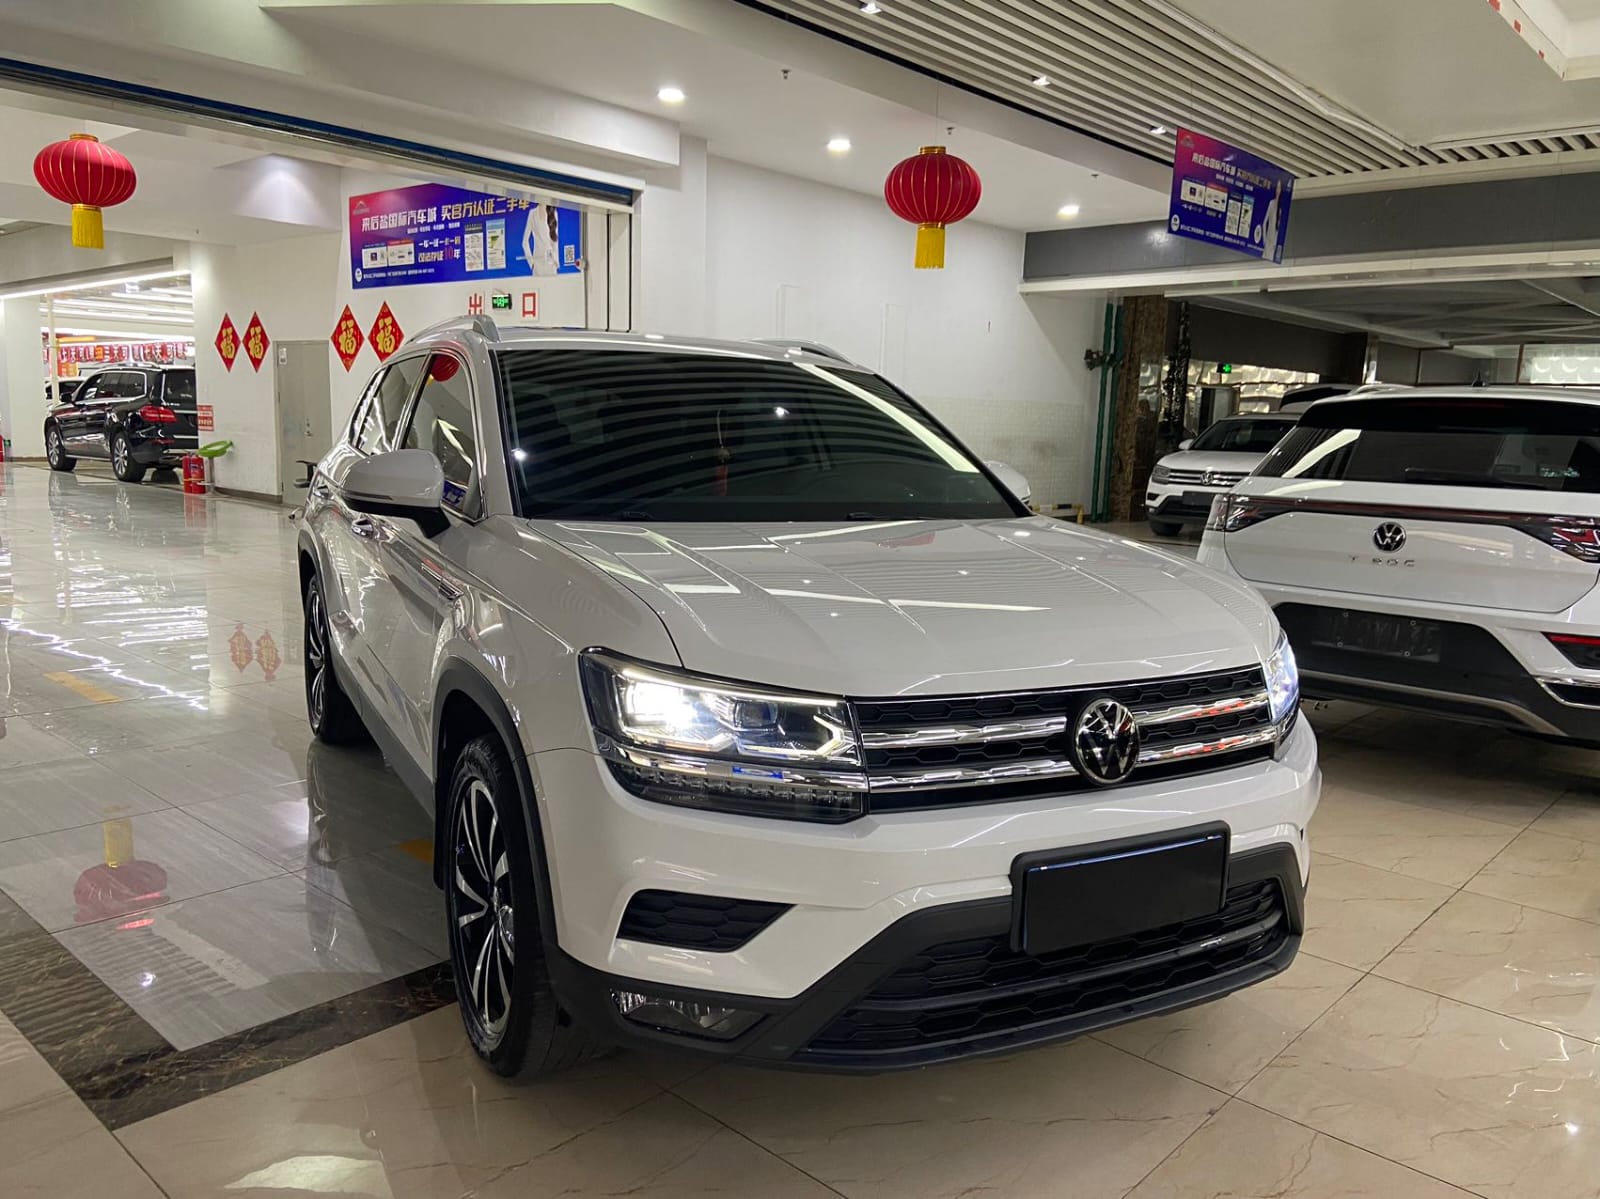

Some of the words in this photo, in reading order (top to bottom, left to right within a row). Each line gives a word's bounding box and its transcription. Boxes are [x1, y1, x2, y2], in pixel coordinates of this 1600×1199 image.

[469, 293, 482, 316] 出
[522, 292, 536, 318] 口
[220, 326, 236, 360] 福
[248, 326, 263, 360] 福
[339, 318, 357, 355] 福
[376, 316, 396, 354] 福
